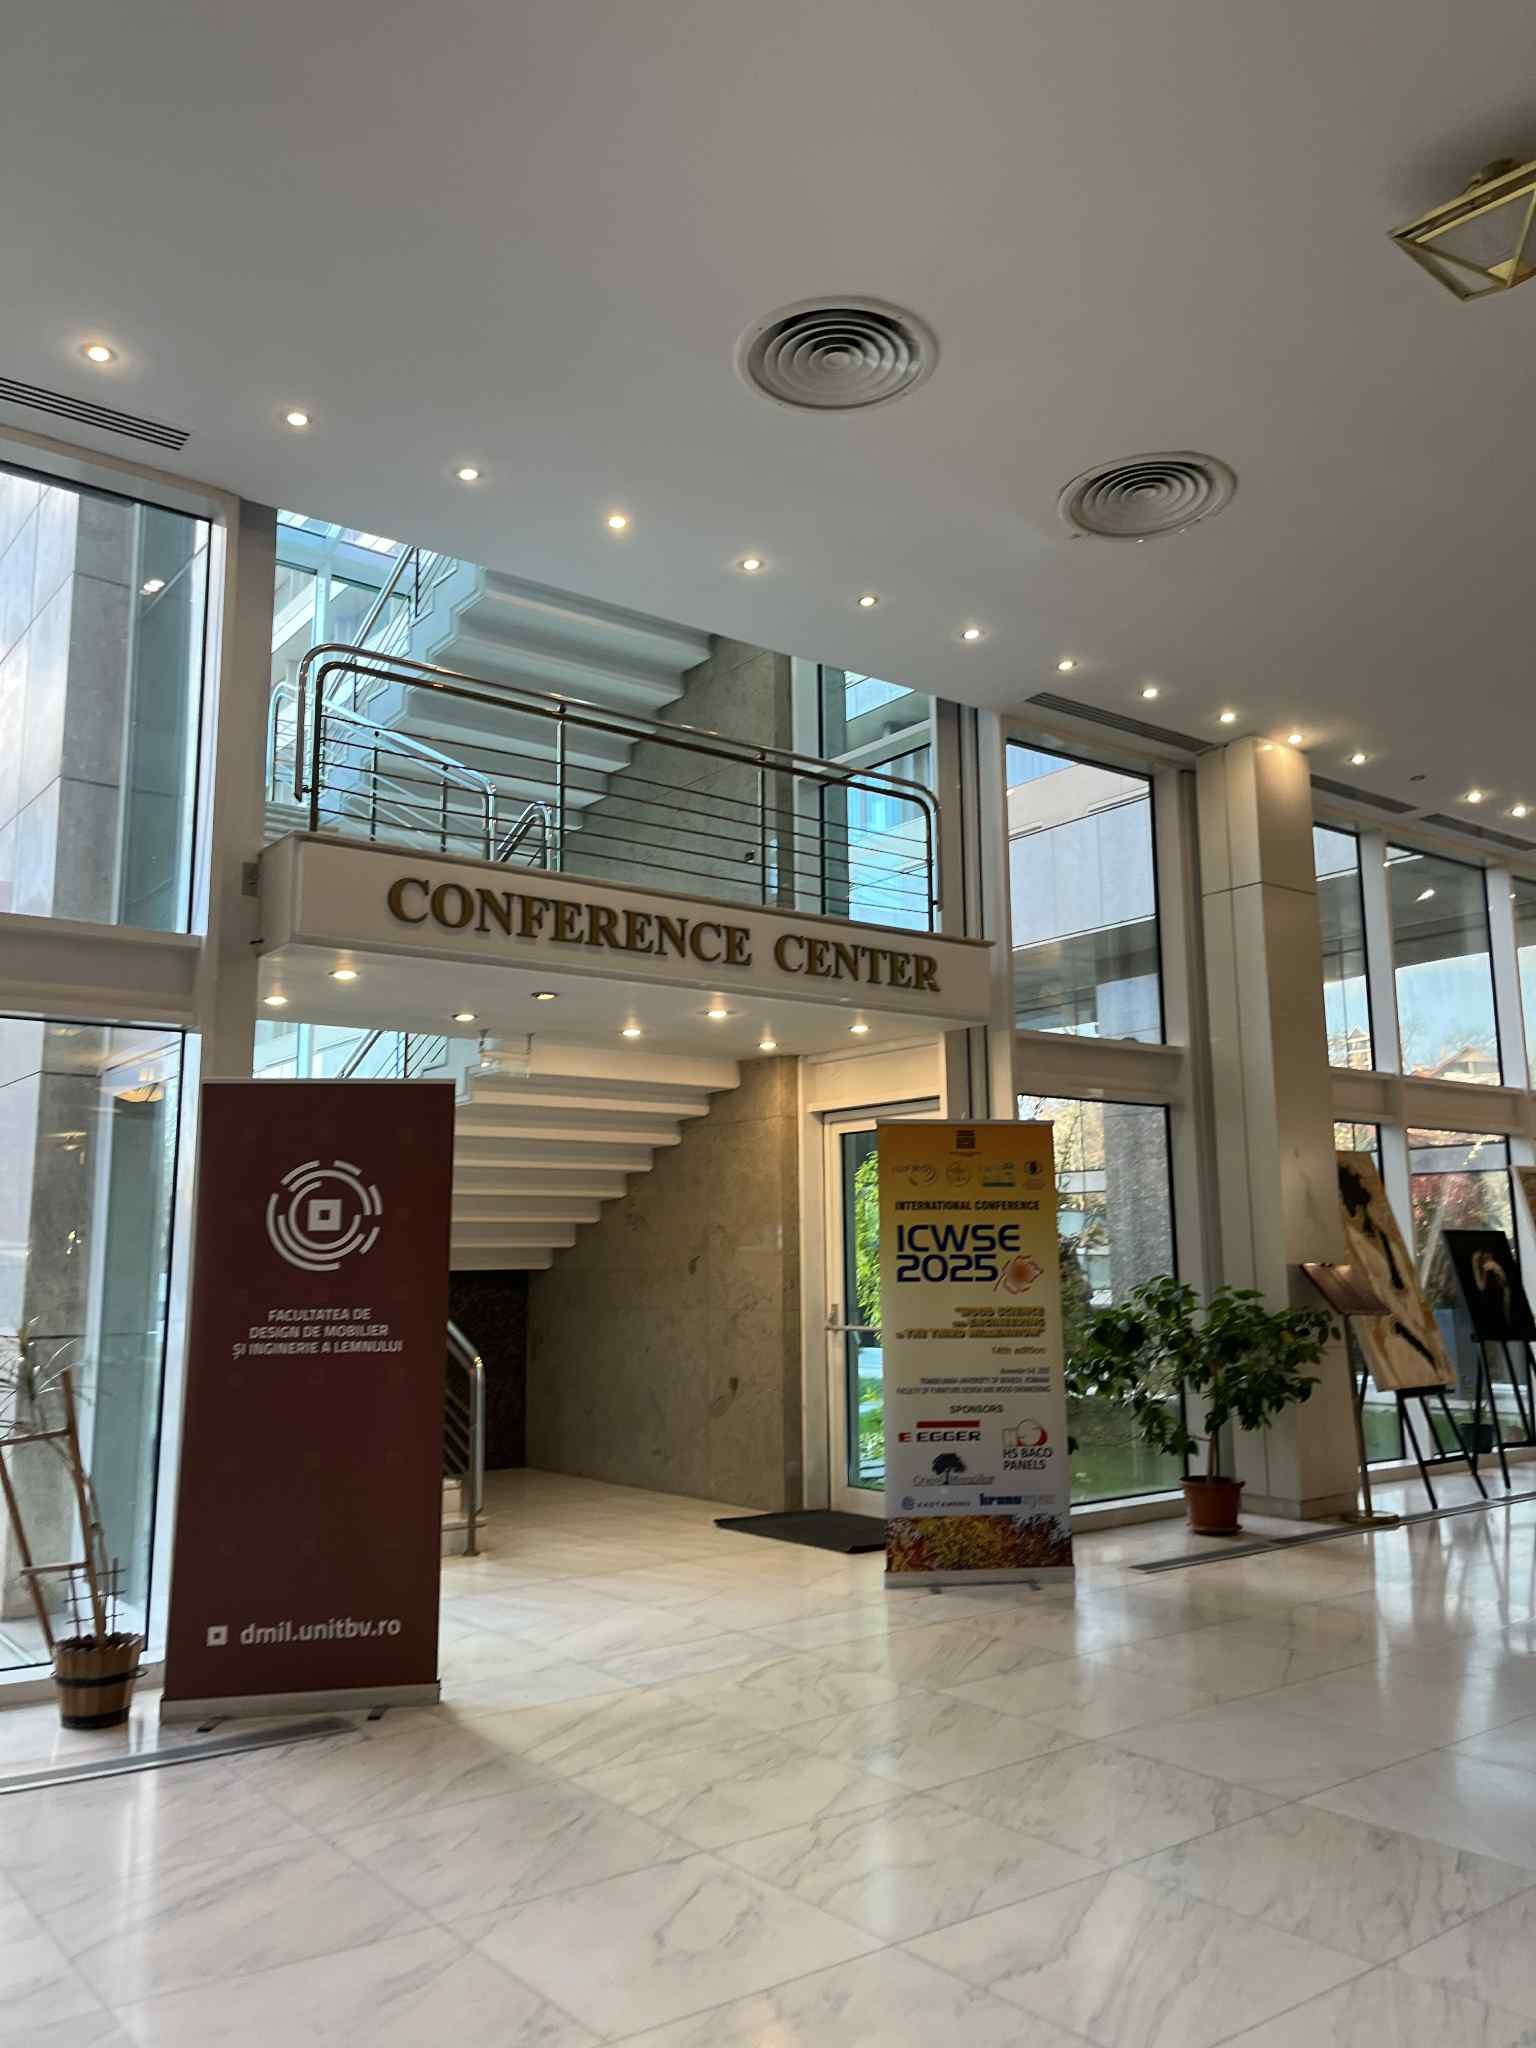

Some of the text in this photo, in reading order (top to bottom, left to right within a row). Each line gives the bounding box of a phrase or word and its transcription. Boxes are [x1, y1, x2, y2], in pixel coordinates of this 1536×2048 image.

[386, 876, 941, 992] CONFERENCE CENTER
[895, 1200, 1040, 1211] INTERNATIONAL CONFERENCE
[897, 1224, 1021, 1252] ICWSE
[897, 1254, 999, 1283] 2025
[268, 1308, 372, 1322] FACULTATEA DE
[249, 1324, 389, 1339] DESIGN DE MOBILIER
[248, 1342, 321, 1355] INGINERIE
[321, 1342, 332, 1353] A
[333, 1340, 404, 1353] LEMNULUI
[916, 1431, 982, 1442] EGGER
[1003, 1459, 1047, 1471] PANELS
[240, 1618, 401, 1645] dmil.unitbv.ro
